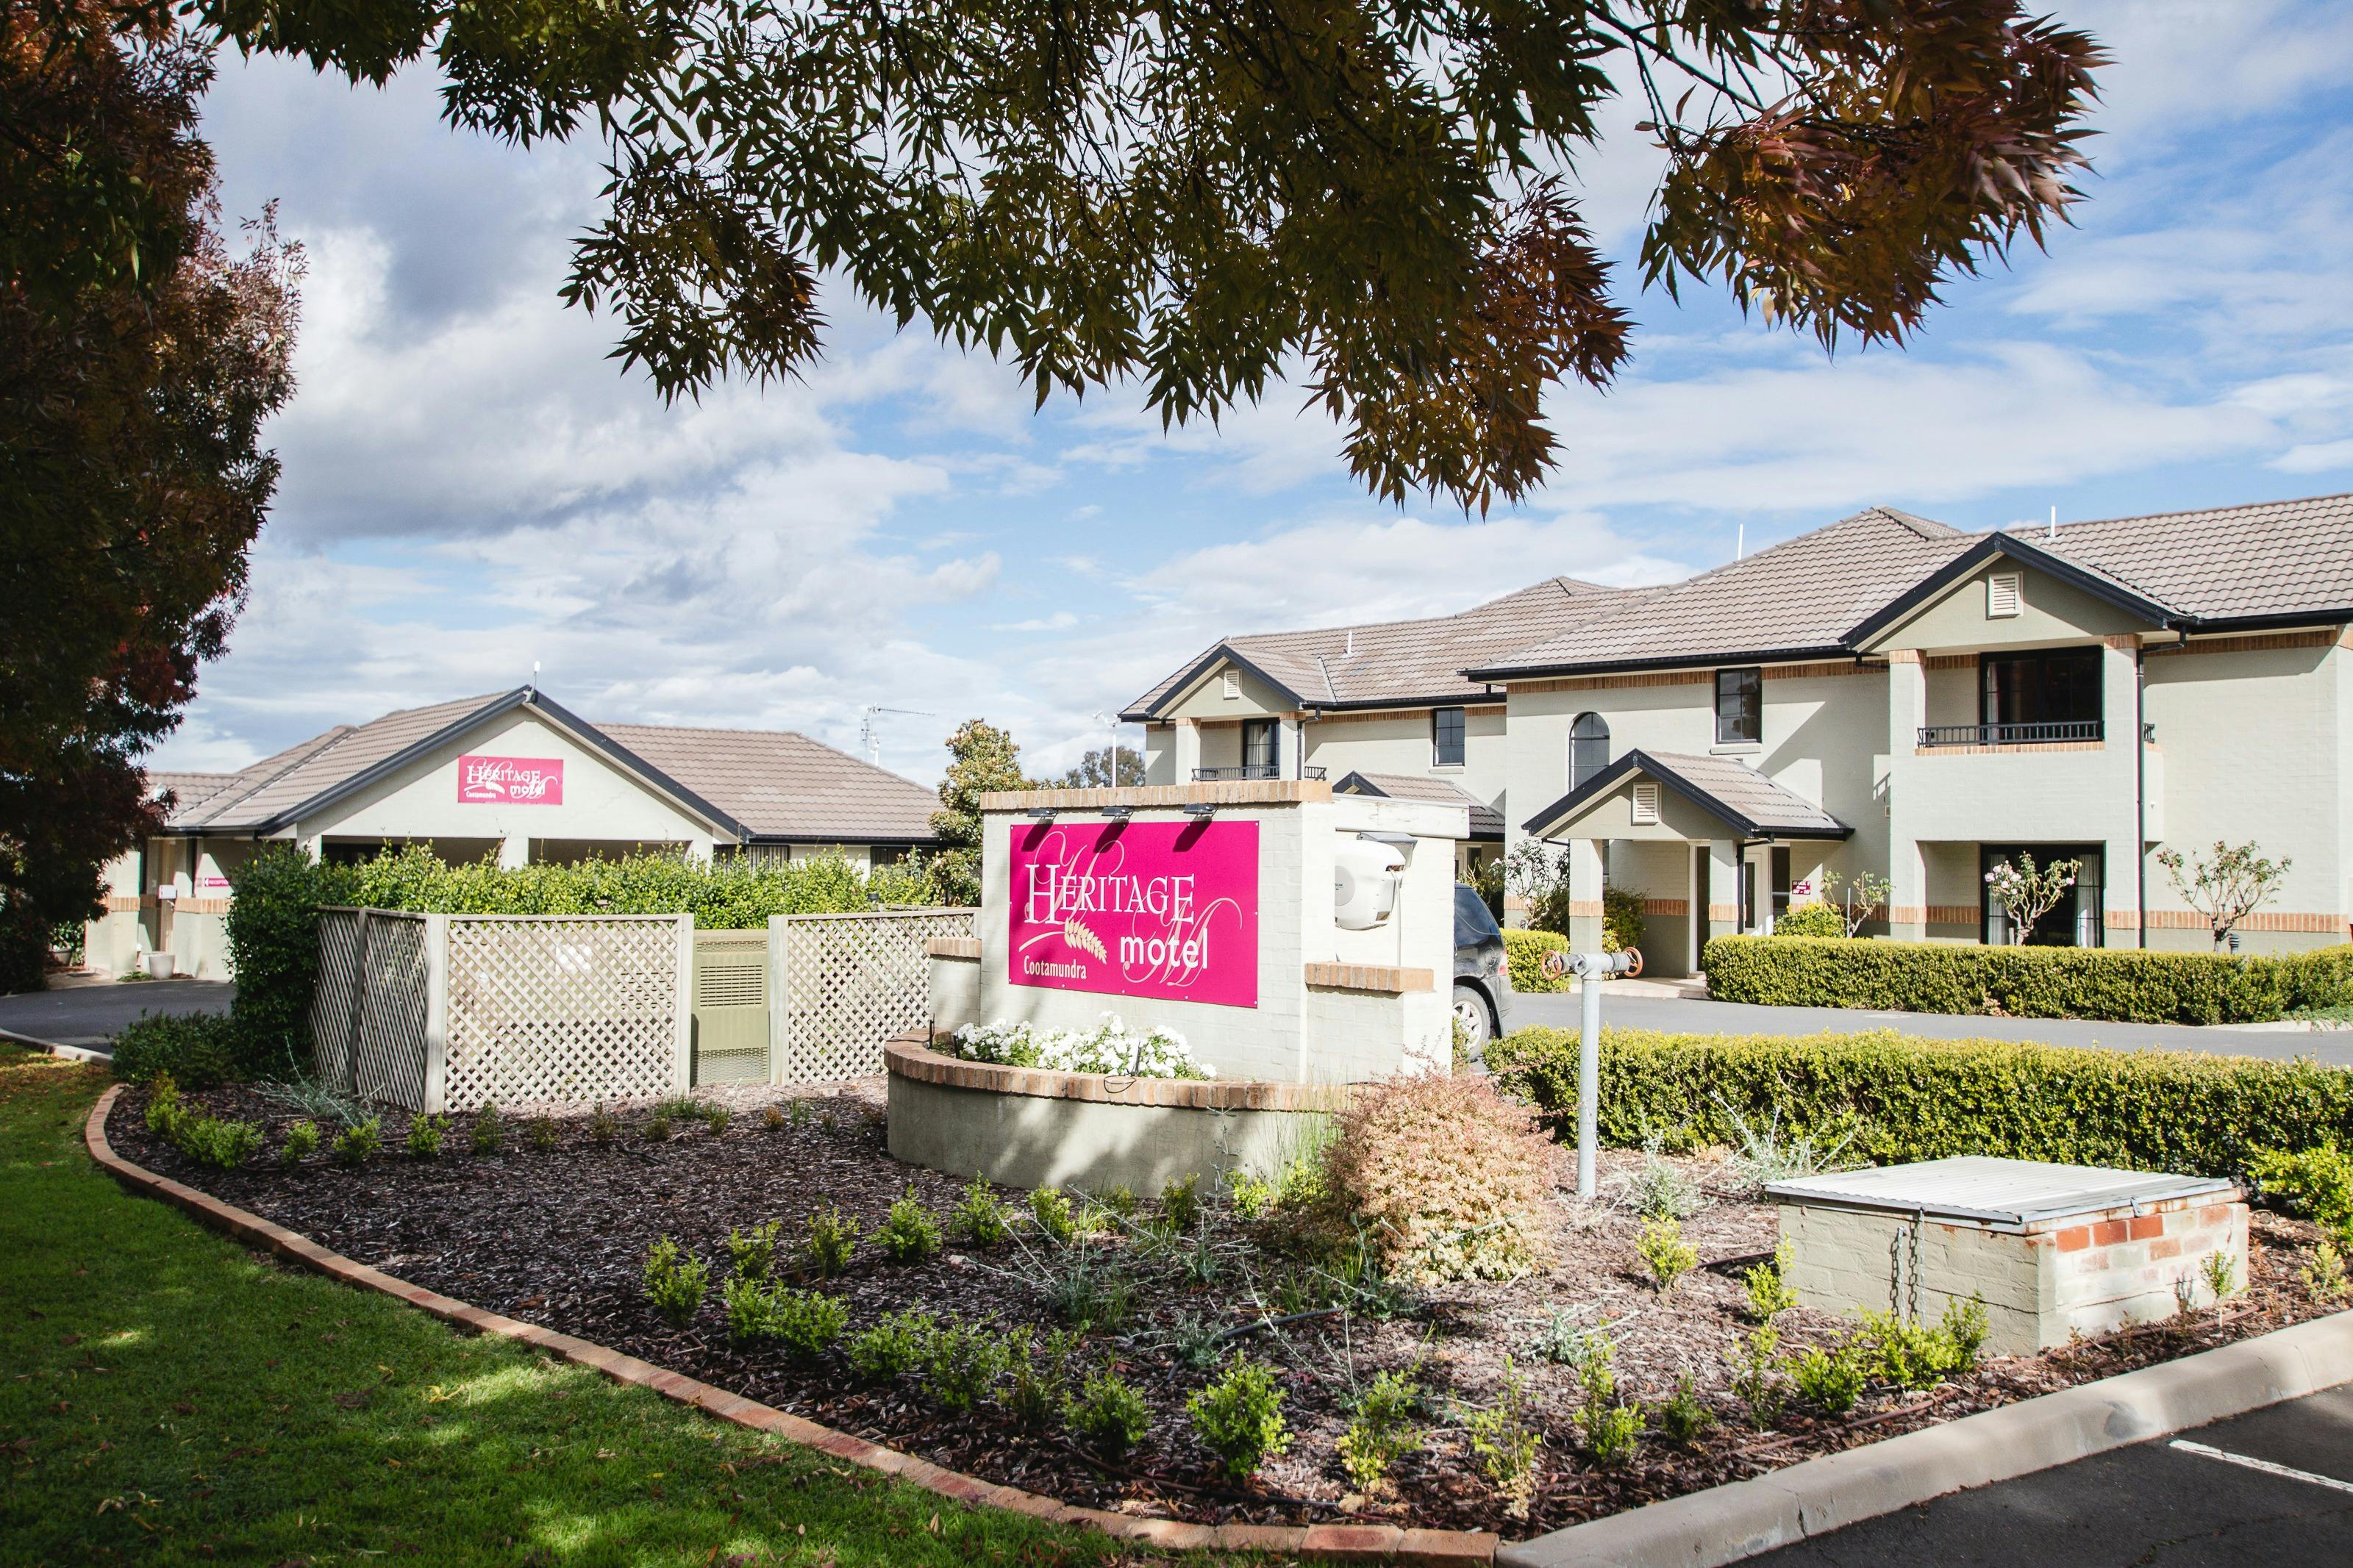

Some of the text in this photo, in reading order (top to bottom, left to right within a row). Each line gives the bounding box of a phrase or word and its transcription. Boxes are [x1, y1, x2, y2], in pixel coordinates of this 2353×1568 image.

[467, 765, 540, 784] HERITAGE
[510, 782, 546, 795] motel
[1024, 864, 1195, 925] HERITAGE
[1120, 928, 1208, 970] motel
[1024, 955, 1087, 979] Cootamundra
